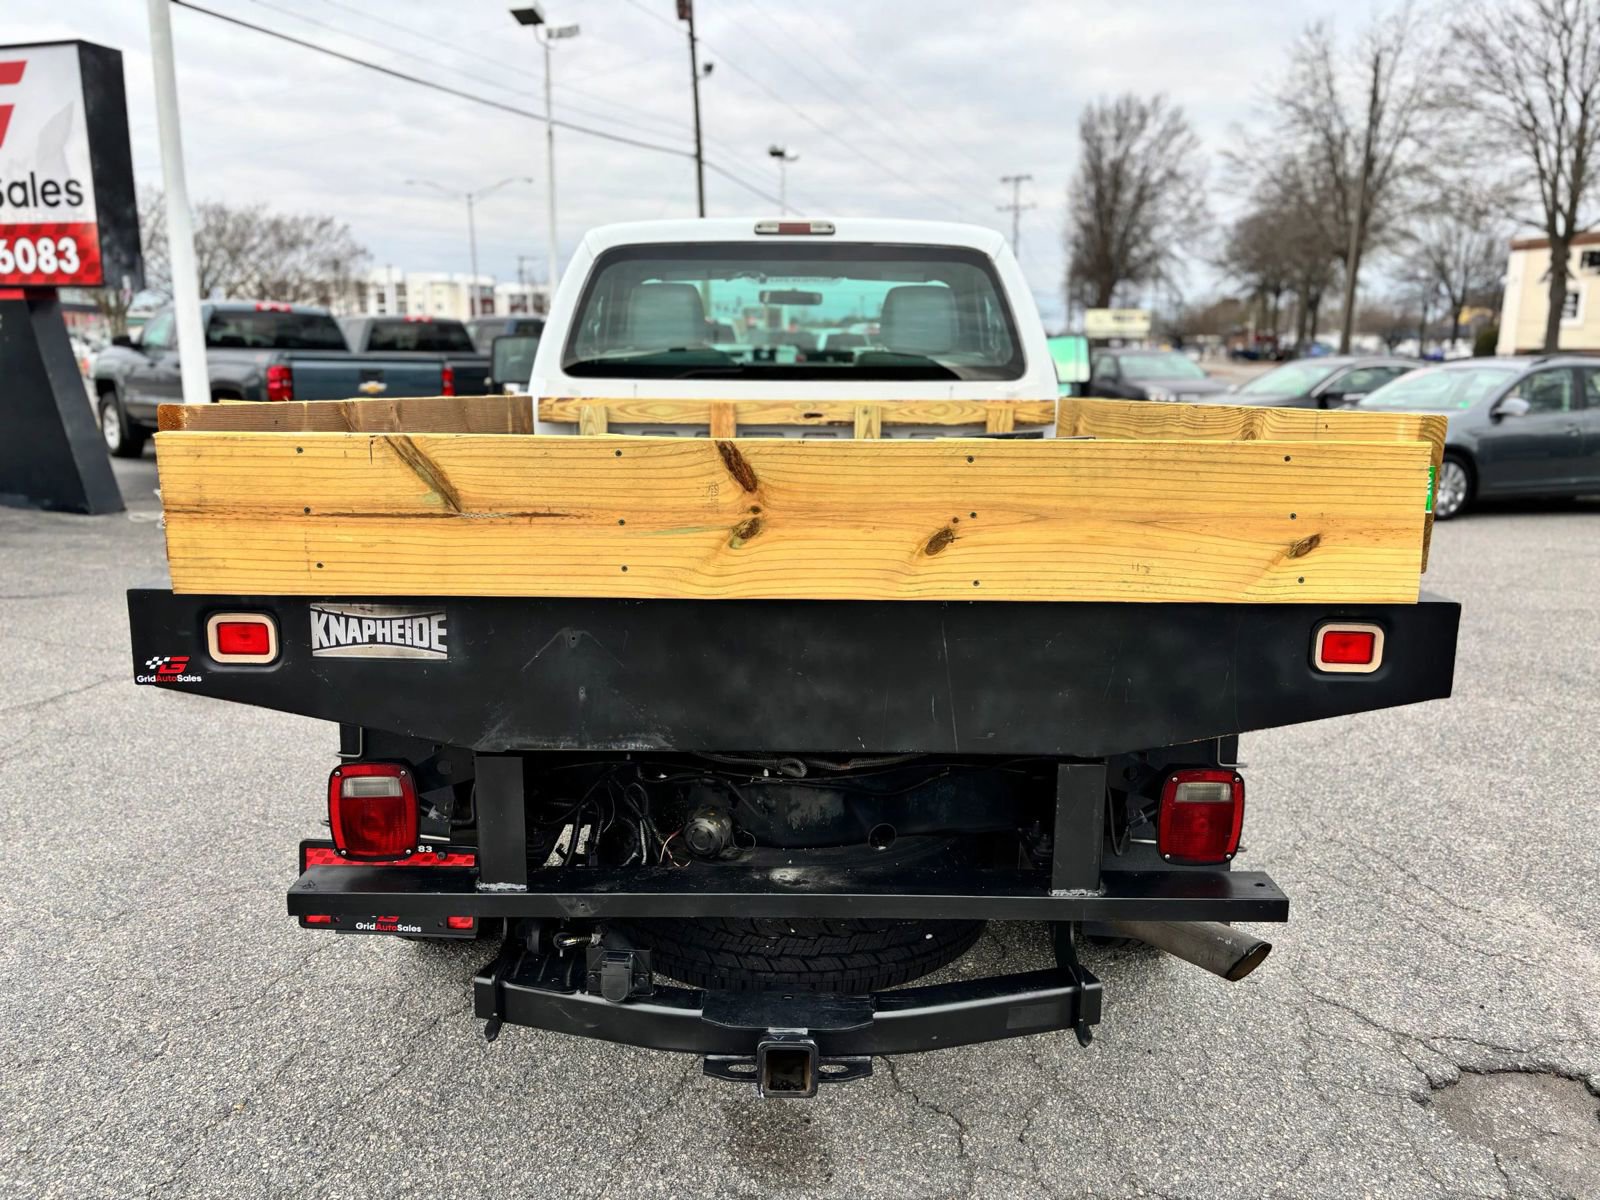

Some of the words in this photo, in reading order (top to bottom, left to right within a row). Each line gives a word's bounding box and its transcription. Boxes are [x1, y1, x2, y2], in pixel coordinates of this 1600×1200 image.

[0, 171, 84, 208] ales
[0, 237, 80, 274] 6083
[310, 610, 448, 653] KNAPHEIDE
[136, 674, 202, 683] GridAutoSales
[417, 845, 433, 853] 83
[355, 922, 422, 933] GridAutoSales
